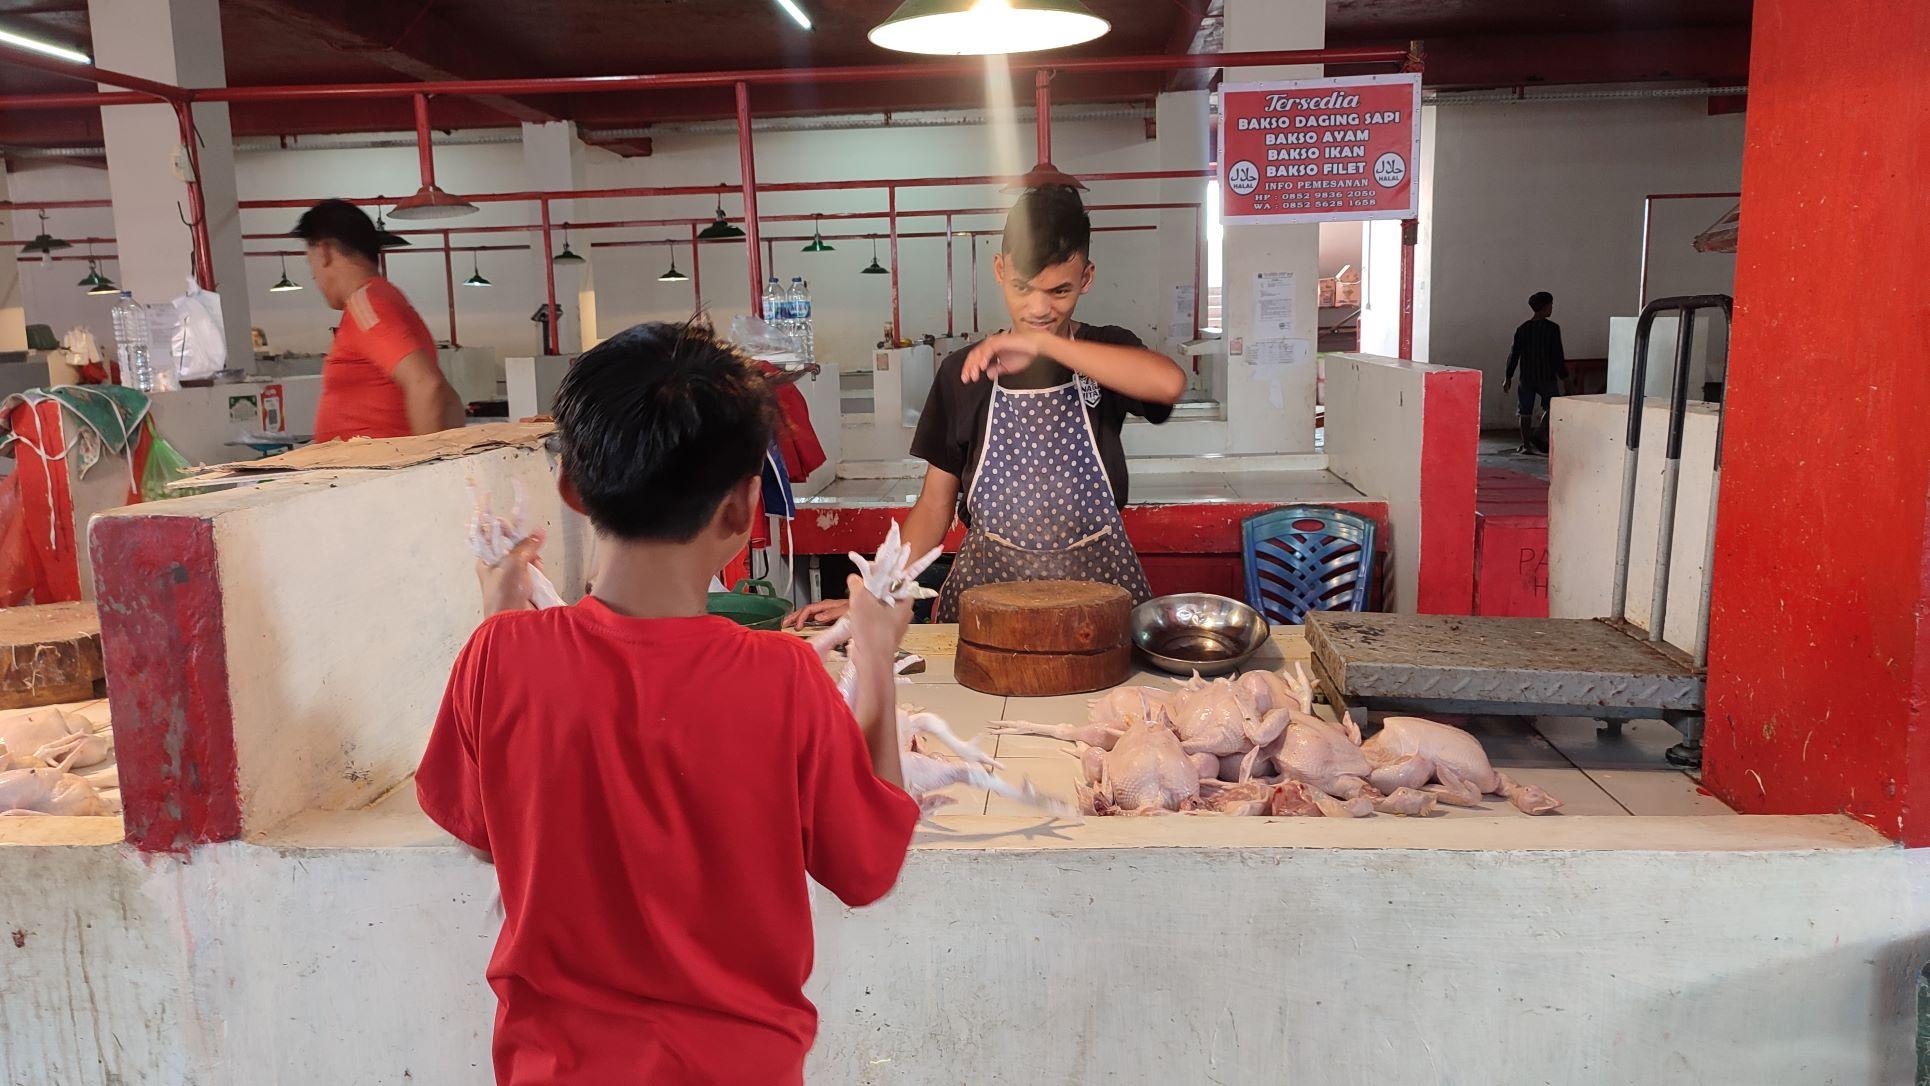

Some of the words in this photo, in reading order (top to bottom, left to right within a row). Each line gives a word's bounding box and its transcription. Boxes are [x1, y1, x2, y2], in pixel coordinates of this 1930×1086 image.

[1264, 91, 1360, 112] Tersedia
[1238, 116, 1290, 131] BAKSO
[1295, 113, 1360, 128] DAGING
[1364, 111, 1401, 125] SAPI
[1264, 131, 1318, 146] BAKSO
[1322, 129, 1370, 143] AYAM
[1267, 147, 1320, 161] BAKSO
[1324, 145, 1366, 159] IKAN
[1266, 163, 1318, 178] BAKSO
[1323, 162, 1366, 175] FILET
[1264, 182, 1293, 191] INFO
[1297, 179, 1369, 189] PEMESANAN
[1281, 192, 1310, 200] 0852
[1282, 201, 1311, 209] 0852
